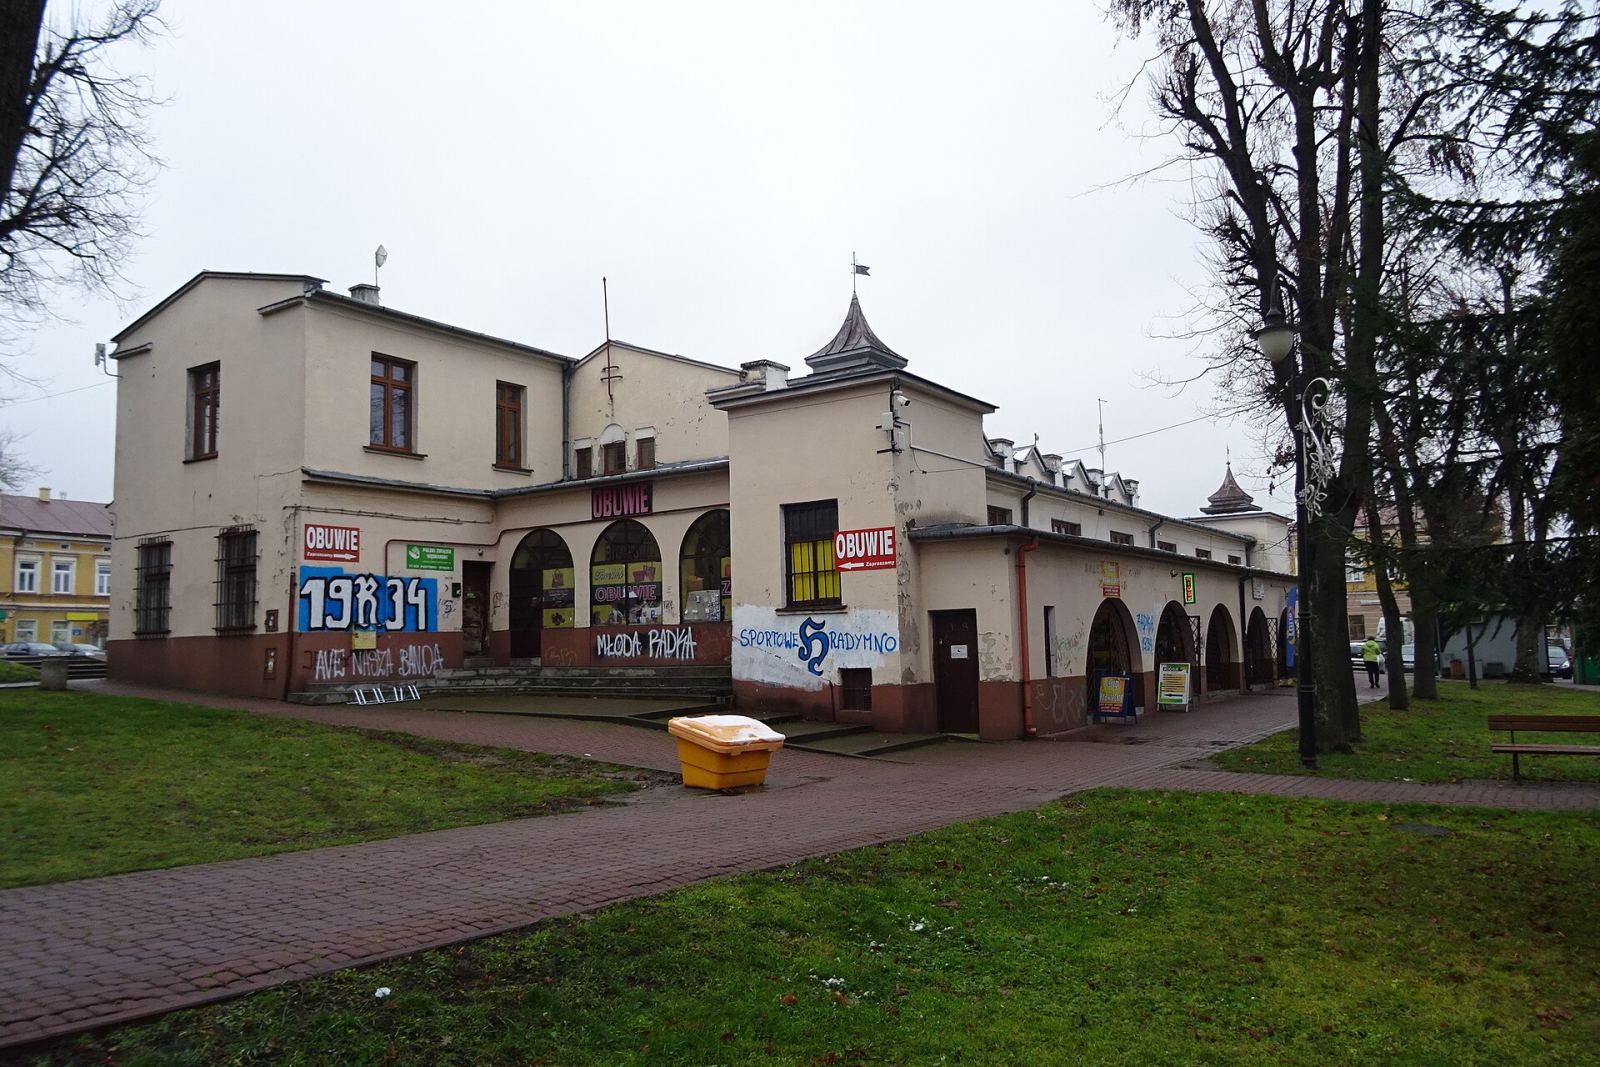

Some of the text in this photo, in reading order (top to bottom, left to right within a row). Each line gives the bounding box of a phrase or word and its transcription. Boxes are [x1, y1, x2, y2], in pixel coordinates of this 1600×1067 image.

[592, 485, 649, 518] OBUWIE
[306, 526, 358, 550] OBUWIE
[835, 529, 893, 559] OBUWIE
[740, 628, 799, 650] SPORTOWE
[829, 630, 897, 654] RADYMNO
[315, 643, 444, 680] AVE NASZA BANDA
